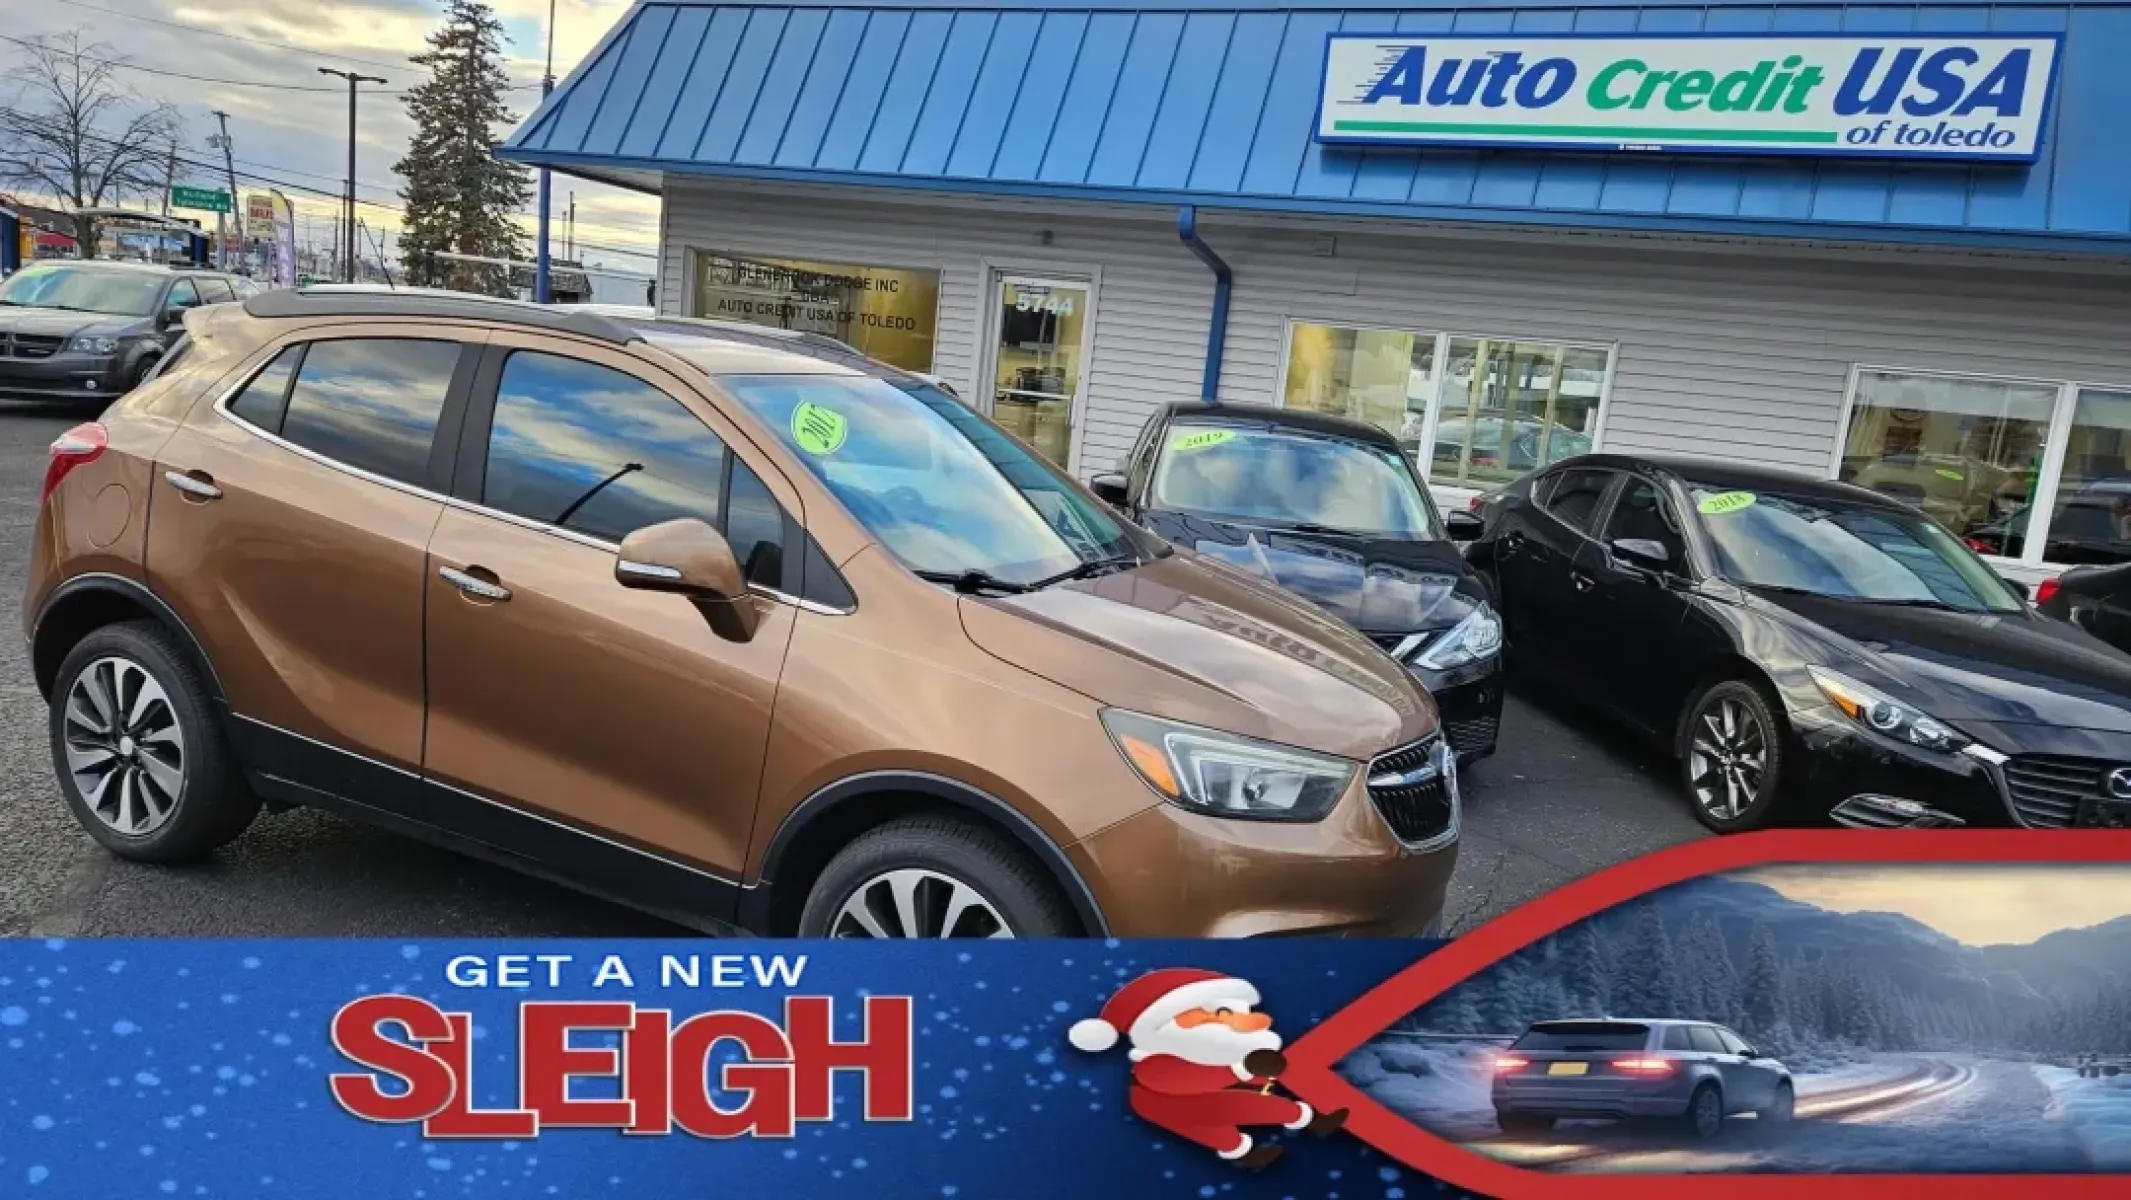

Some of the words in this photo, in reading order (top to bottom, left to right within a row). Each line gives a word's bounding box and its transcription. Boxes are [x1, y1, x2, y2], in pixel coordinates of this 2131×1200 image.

[1356, 45, 1577, 109] Auto
[1585, 53, 1824, 114] Credit
[1833, 46, 2032, 118] USA
[1846, 120, 1892, 145] of
[1893, 121, 2017, 149] toledo
[875, 278, 899, 293] INC
[717, 299, 753, 313] AUTO
[806, 307, 835, 322] USA
[838, 310, 856, 324] OF
[859, 312, 917, 332] TOLEDO
[1016, 293, 1073, 316] 5744
